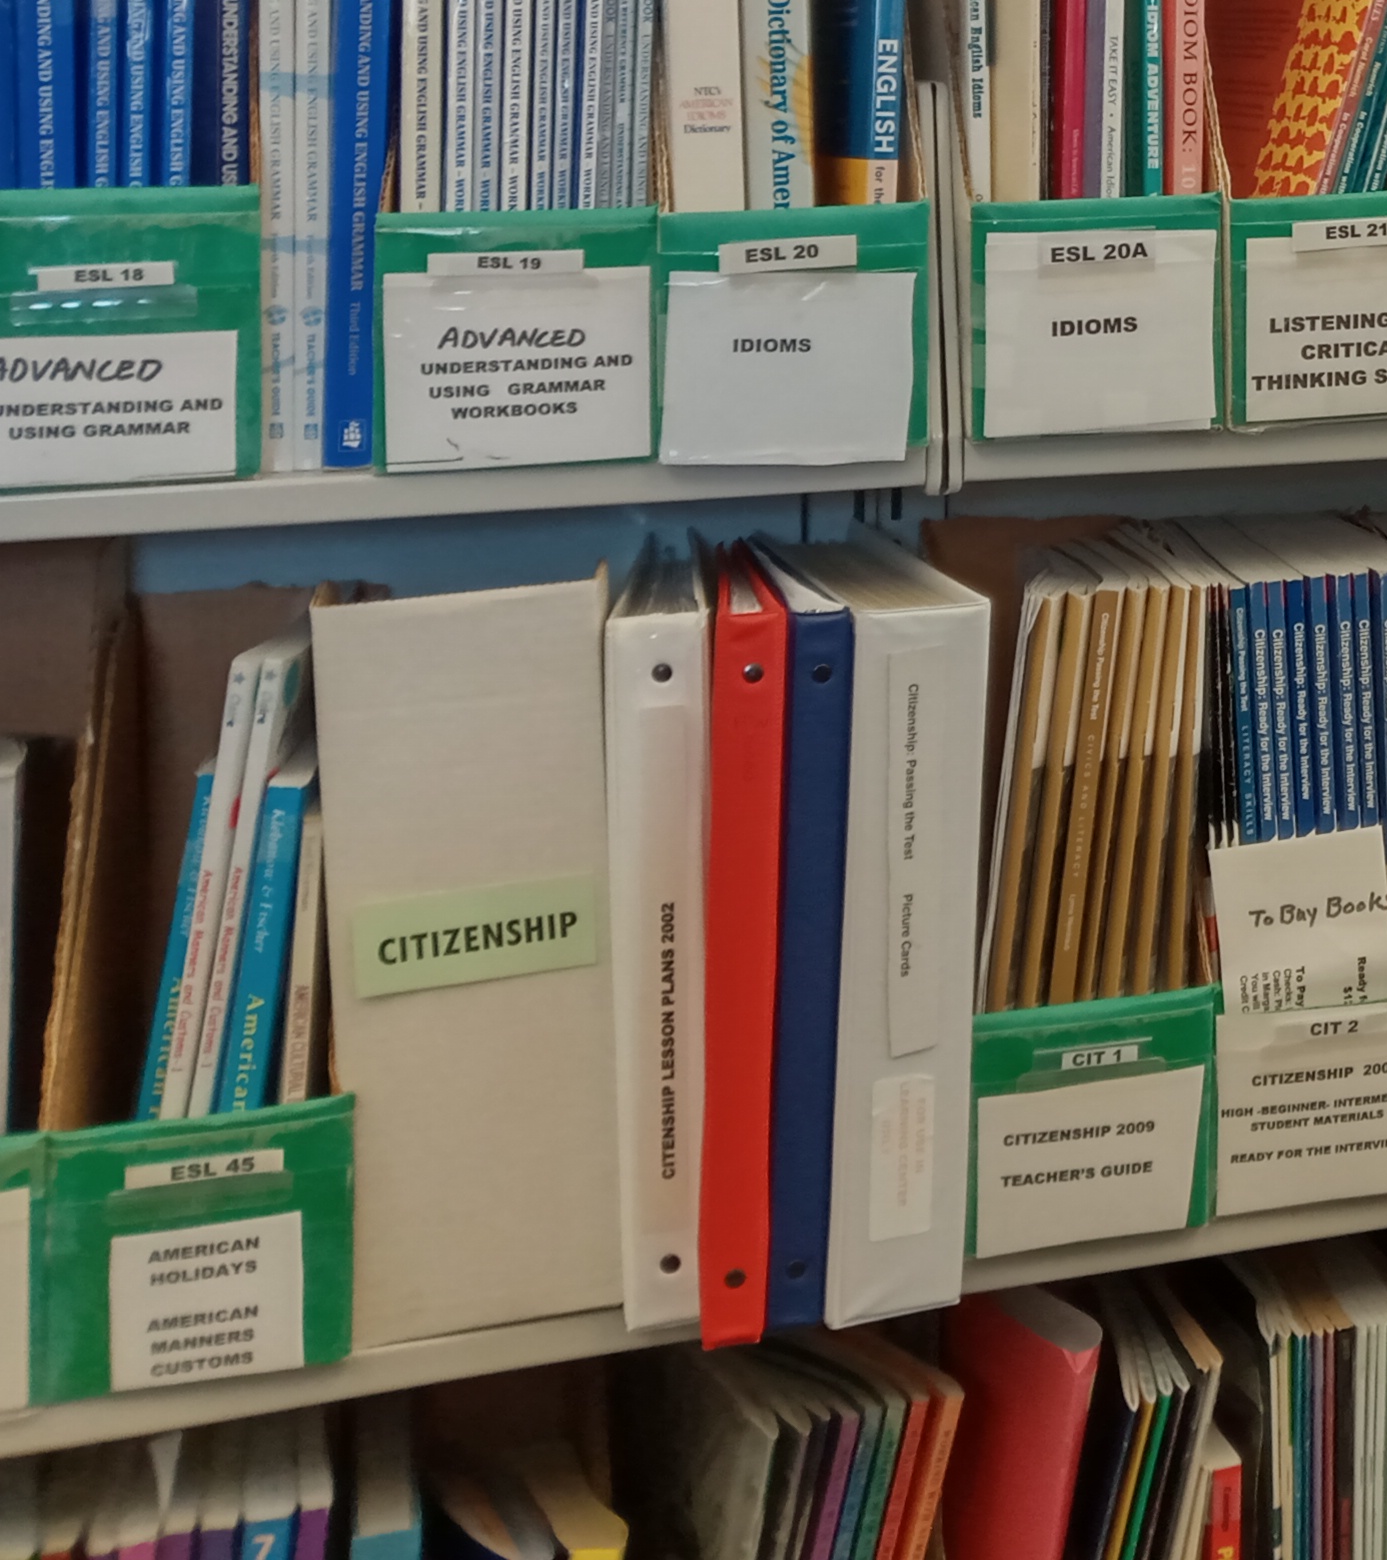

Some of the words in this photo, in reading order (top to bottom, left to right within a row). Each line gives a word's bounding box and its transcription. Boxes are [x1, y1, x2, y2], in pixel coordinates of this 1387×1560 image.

[873, 39, 898, 152] ENGLISH
[1051, 246, 1095, 262] ESL
[1104, 243, 1148, 260] 20A
[438, 327, 585, 349] ADVANCED
[733, 339, 811, 352] IDIOMS
[421, 356, 587, 375] UNDERSTANDING
[594, 354, 632, 367] AND
[429, 385, 490, 399] USING
[508, 379, 605, 395] GRAMMAR
[1252, 370, 1366, 391] THINKING
[451, 402, 577, 419] WORKBOOKS
[661, 902, 674, 943] 2002
[1280, 904, 1317, 927] Buy
[379, 912, 577, 964] CITIZENSHIP
[662, 949, 674, 1006] PLANS
[662, 1011, 675, 1076] LESSON
[1001, 1168, 1095, 1187] TEACHER'S
[1101, 1161, 1152, 1177] GUIDE
[148, 1236, 260, 1263] AMERICAN
[150, 1261, 258, 1286] HOLIDAYS
